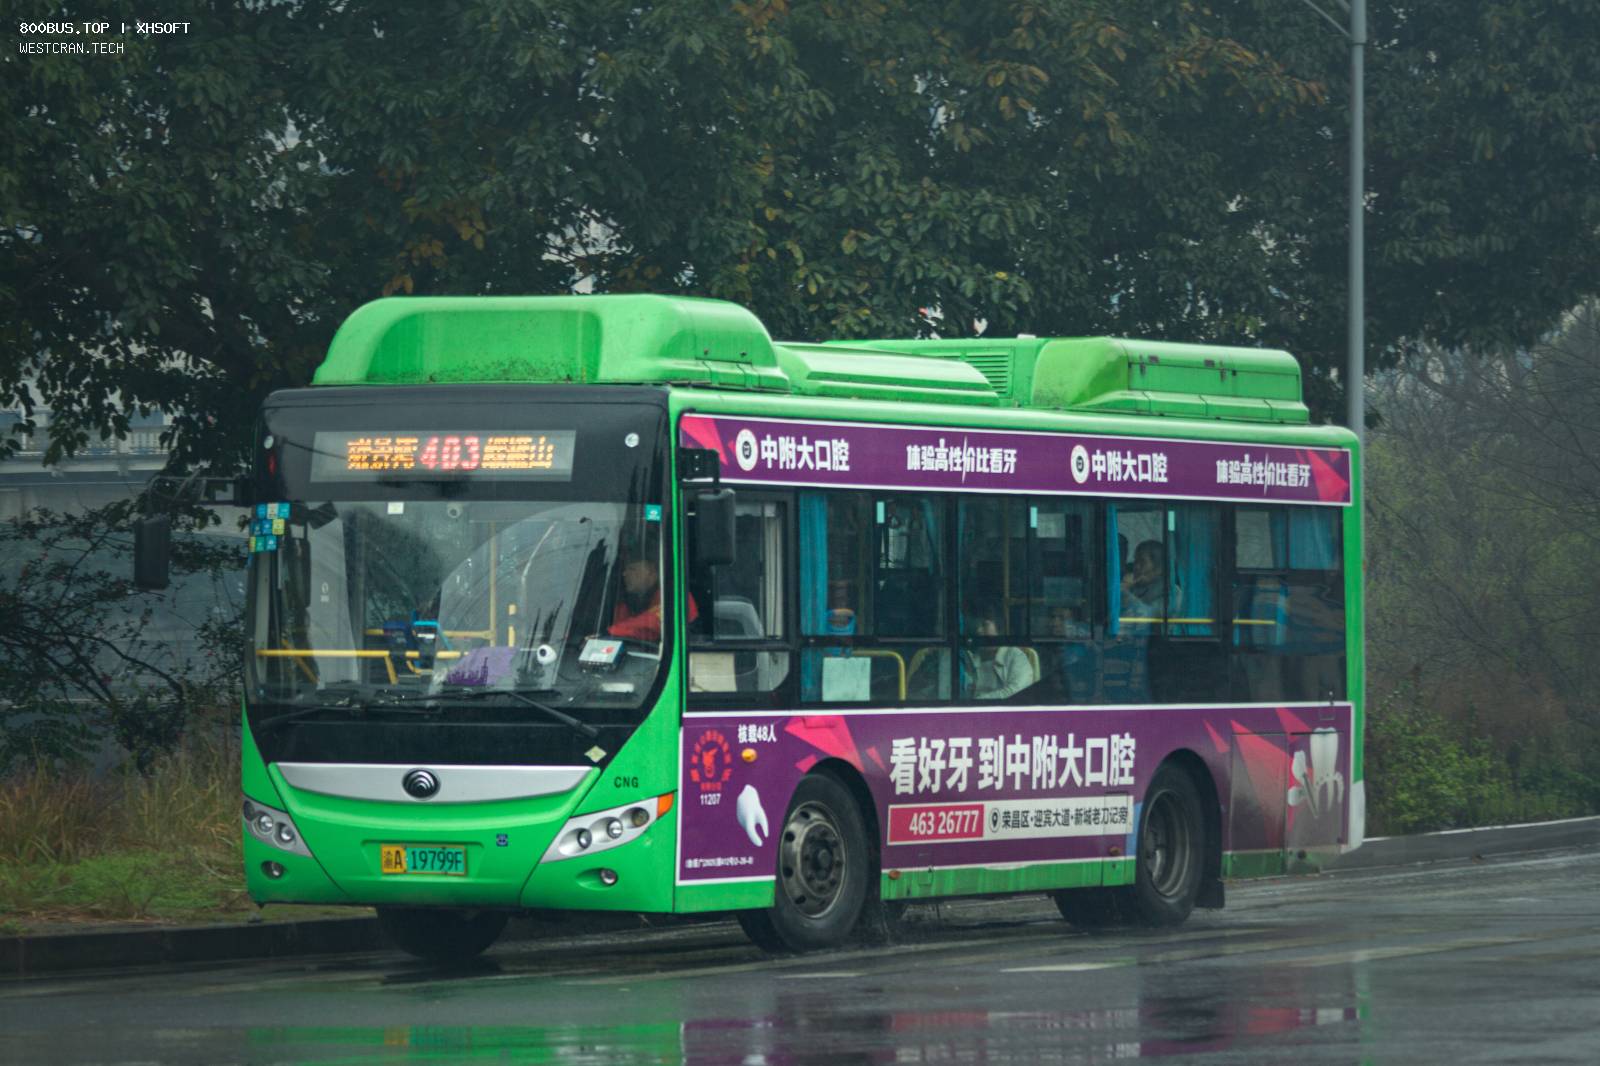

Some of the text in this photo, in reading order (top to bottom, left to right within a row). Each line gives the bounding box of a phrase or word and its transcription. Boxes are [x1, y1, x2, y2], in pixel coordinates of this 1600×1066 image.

[421, 436, 479, 470] 403
[760, 434, 850, 472] 中附大口腔
[906, 436, 1017, 483] 体验高性价比看牙
[1091, 449, 1168, 483] 中附大口腔
[889, 732, 1136, 795] 看好牙 到中附大口腔
[614, 776, 639, 788] CNG
[909, 810, 979, 836] 463 26777
